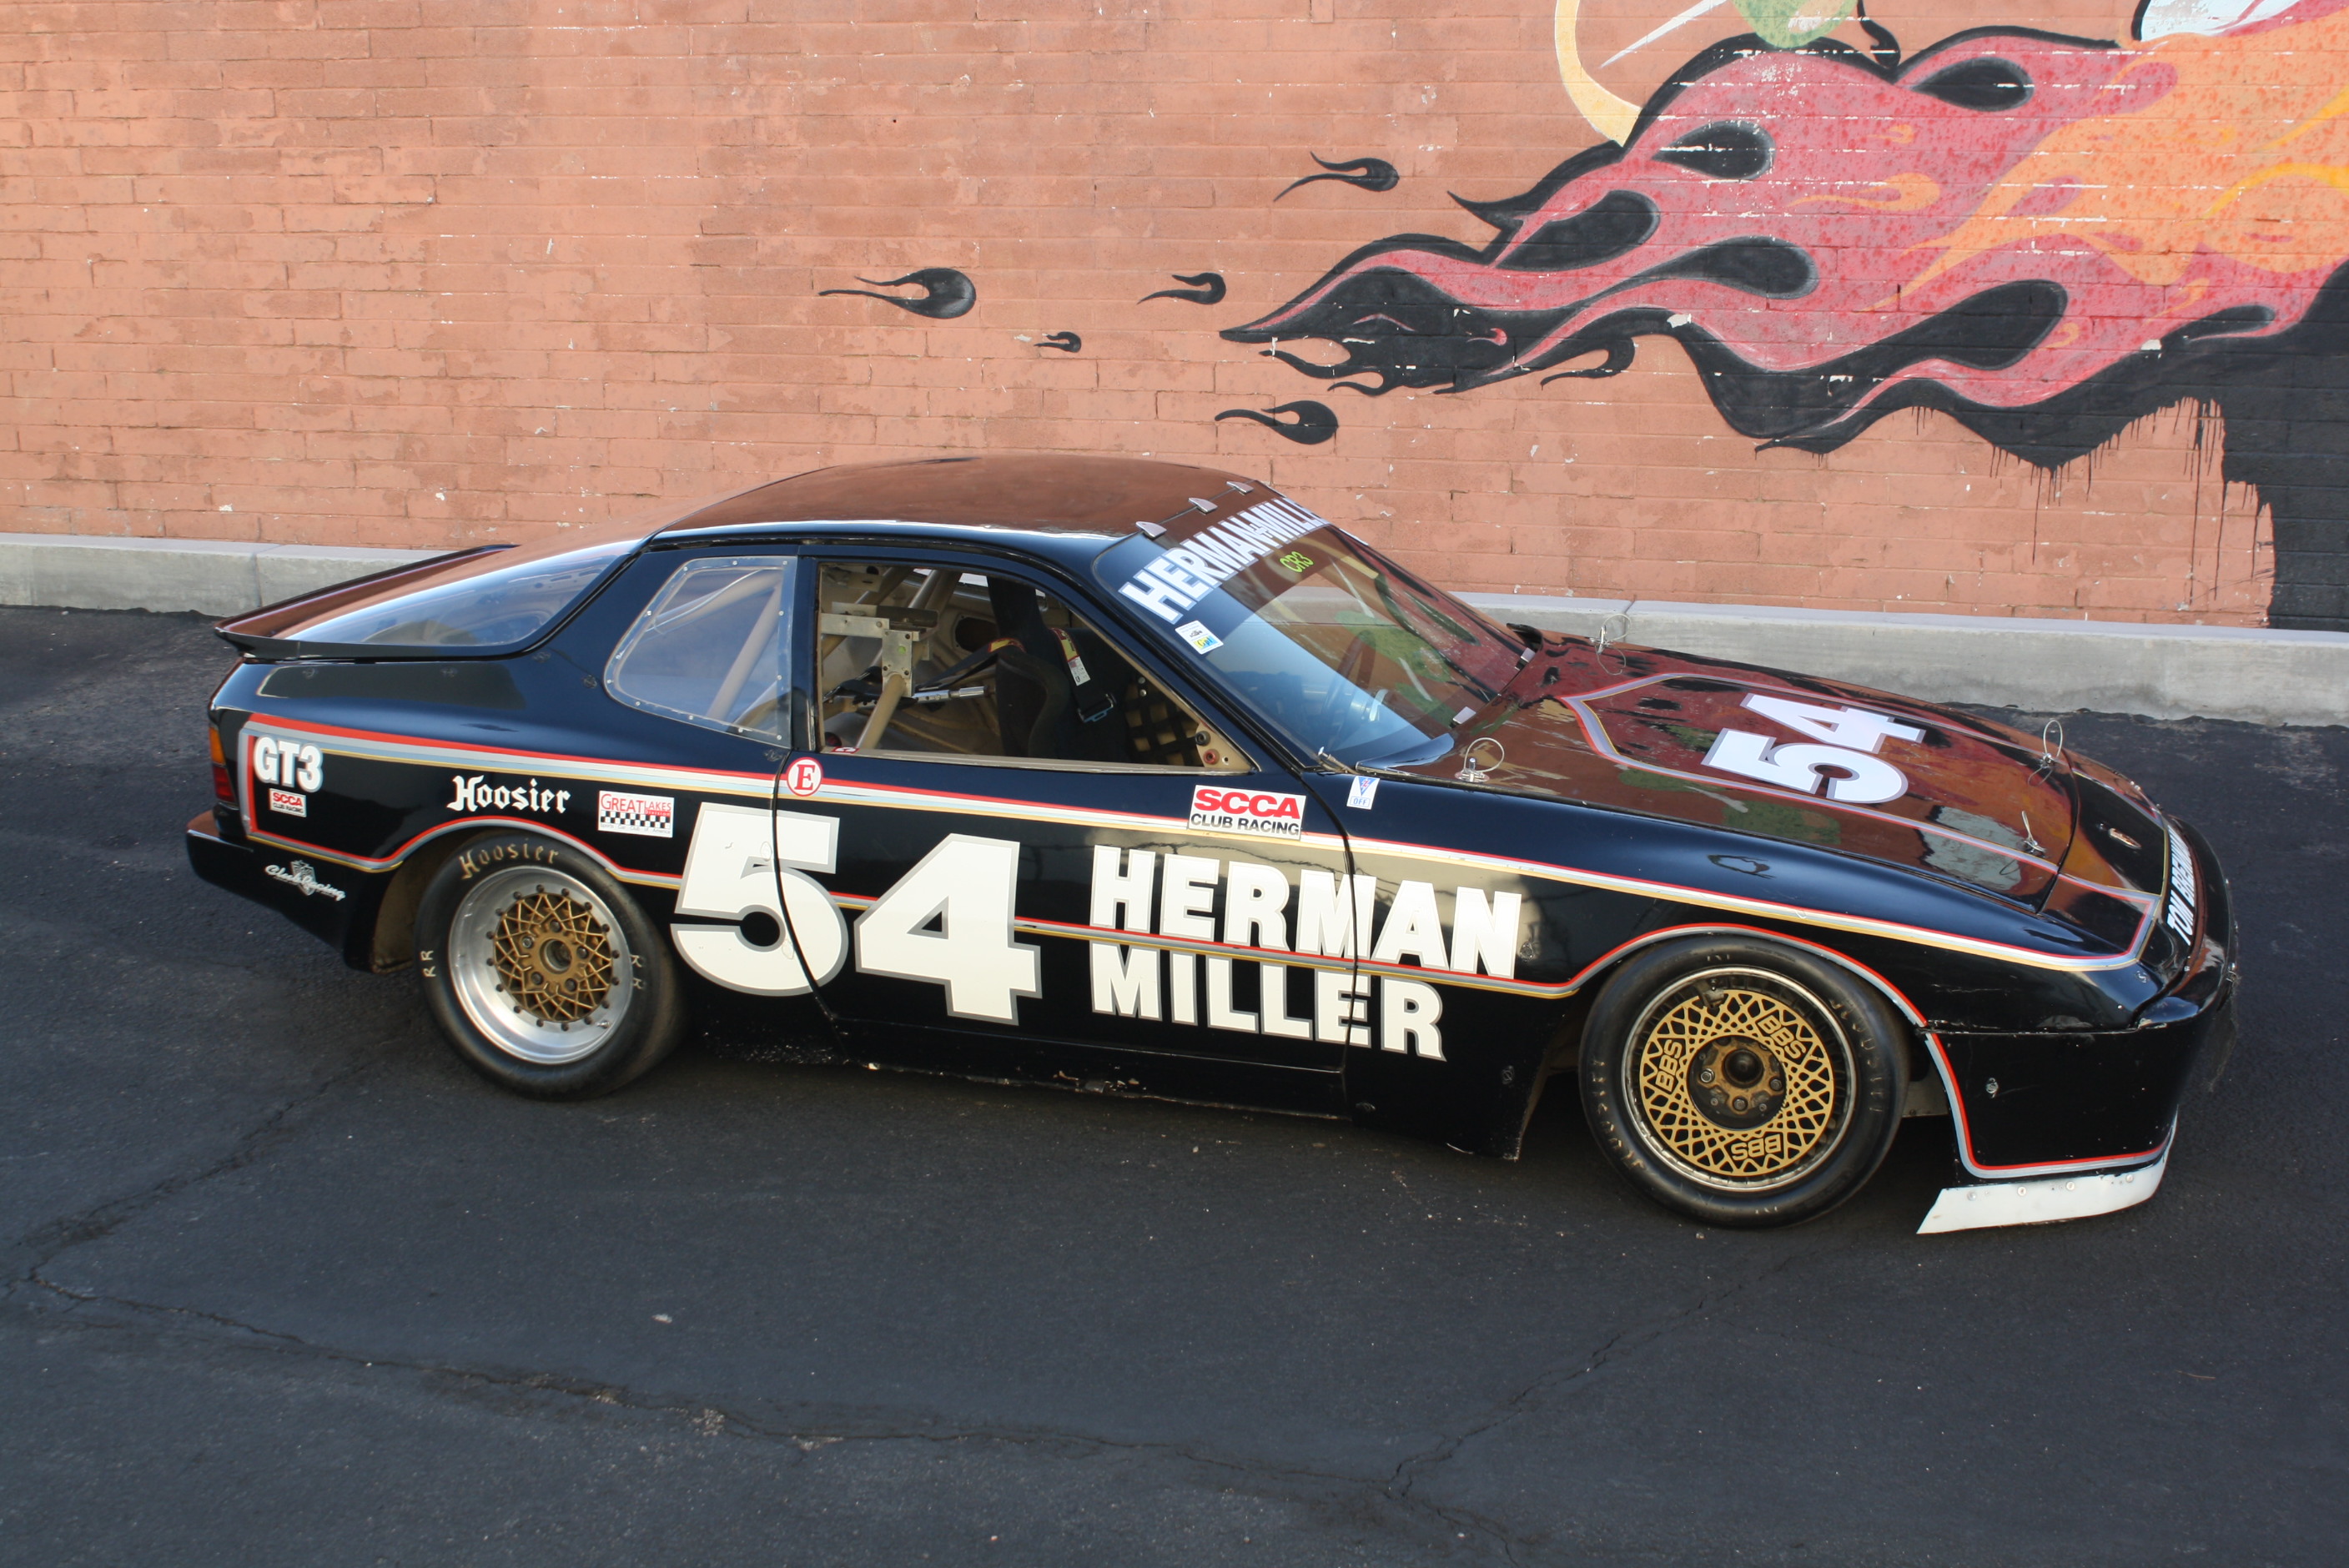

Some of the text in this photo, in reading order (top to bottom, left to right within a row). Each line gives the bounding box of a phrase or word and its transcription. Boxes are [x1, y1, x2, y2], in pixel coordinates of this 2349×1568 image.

[1280, 551, 1314, 572] CR3
[254, 736, 323, 792] GT3
[1701, 692, 1927, 803] 54
[446, 775, 571, 814] Hoosier
[794, 764, 816, 791] E
[273, 792, 304, 807] SCCA
[1194, 789, 1300, 819] SCCA
[1353, 797, 1366, 806] OFF
[1190, 813, 1300, 836] CLUB RACING
[459, 838, 559, 880] Hoosier
[670, 802, 1043, 1025] 54
[1089, 845, 1522, 979] HERMAN
[2167, 889, 2194, 946] TOM
[1089, 939, 1447, 1062] MILLER
[1757, 1015, 1807, 1059] BBS
[1655, 1039, 1683, 1093] BBS
[1731, 1133, 1782, 1161] BBS
